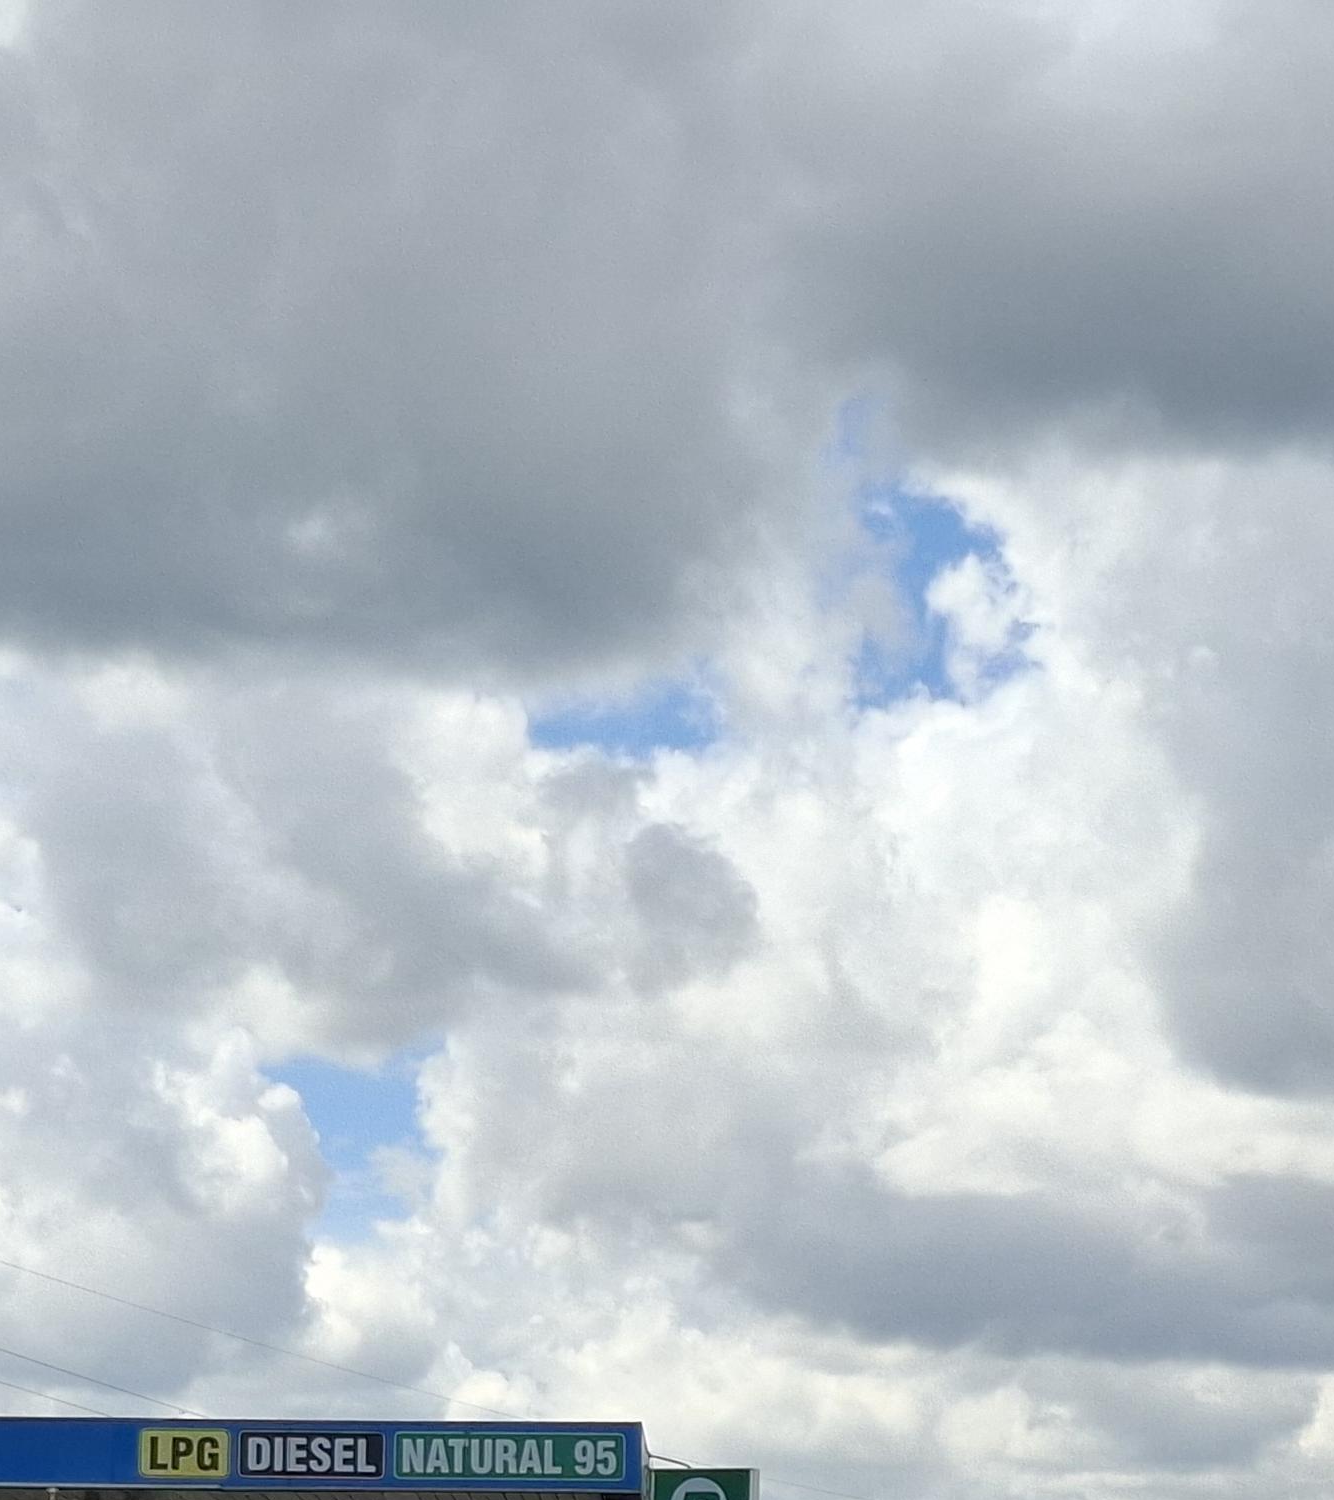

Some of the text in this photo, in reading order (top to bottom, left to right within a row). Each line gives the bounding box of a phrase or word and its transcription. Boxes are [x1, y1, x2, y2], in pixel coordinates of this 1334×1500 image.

[149, 1436, 221, 1472] LPG
[247, 1436, 377, 1473] DIESEL
[401, 1438, 617, 1476] NATURAL 95
